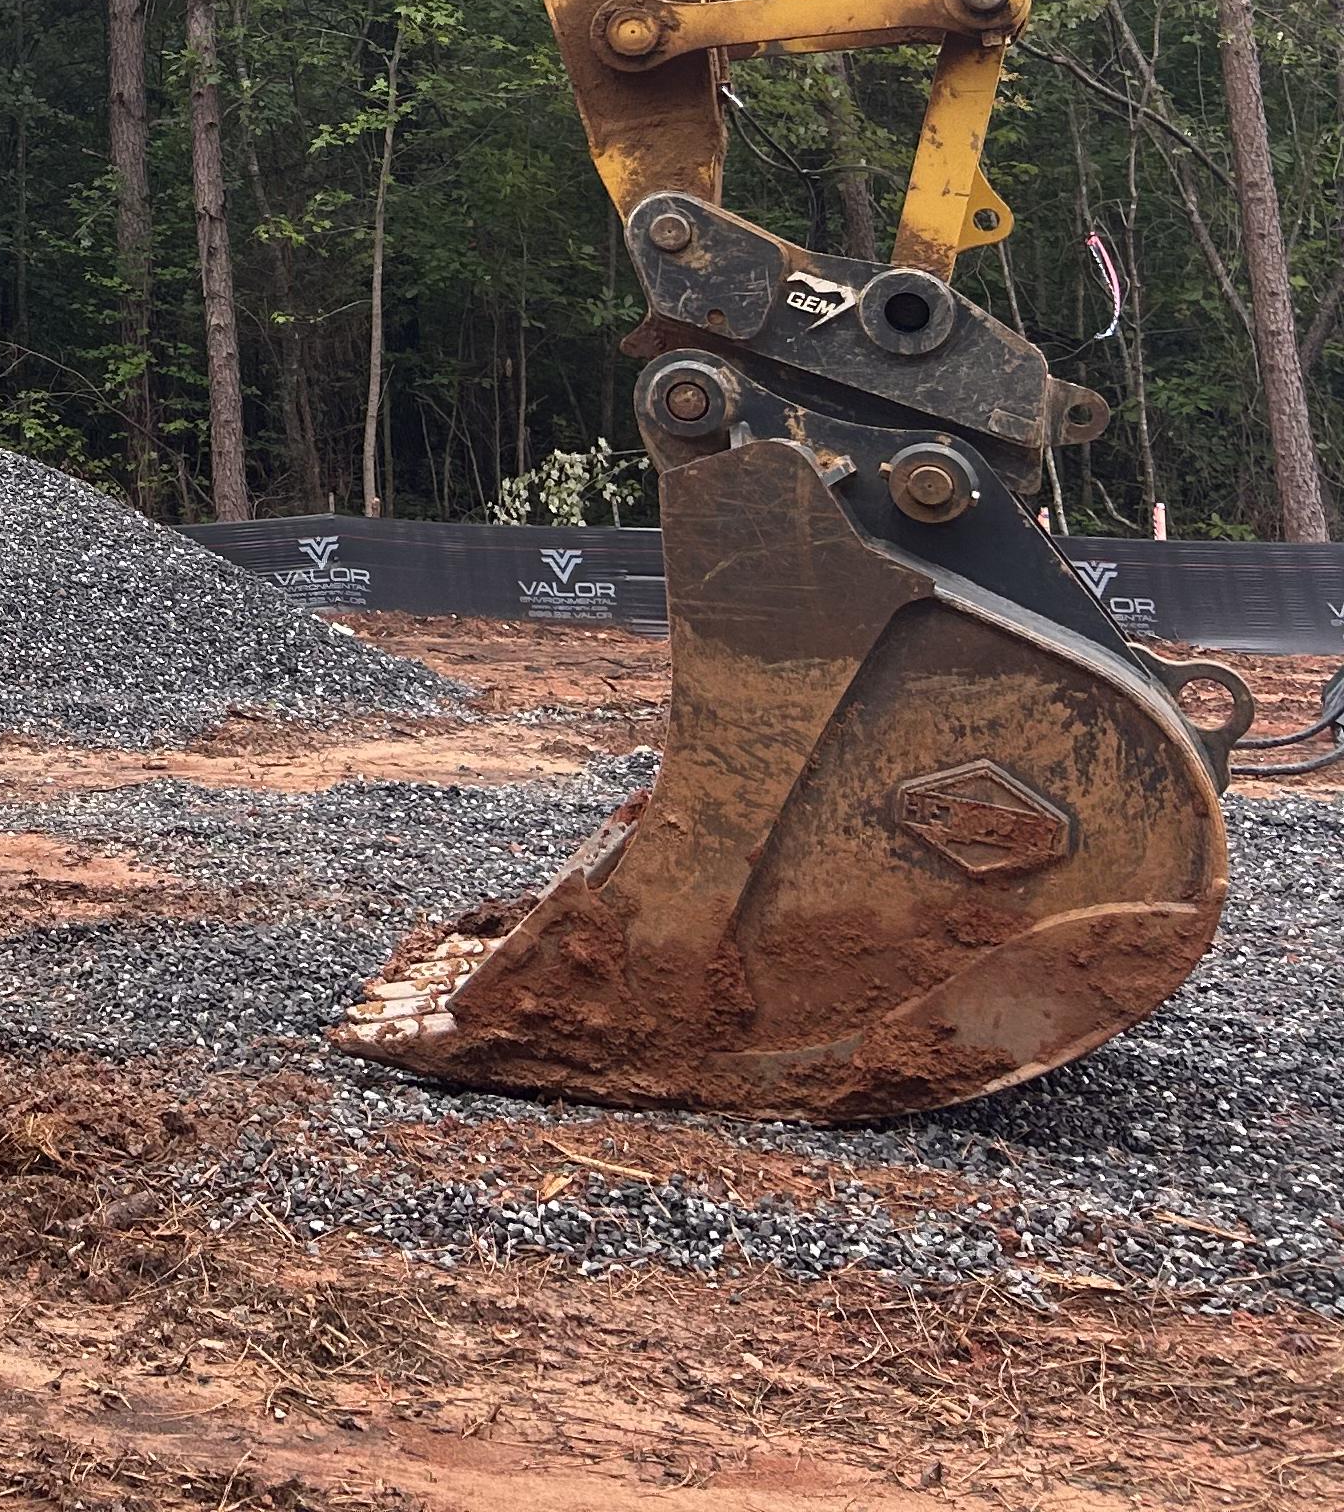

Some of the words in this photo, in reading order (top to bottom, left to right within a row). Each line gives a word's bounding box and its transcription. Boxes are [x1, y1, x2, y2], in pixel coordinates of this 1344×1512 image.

[786, 291, 837, 317] GEM
[273, 567, 371, 585] VALOR
[518, 581, 616, 598] VALOR
